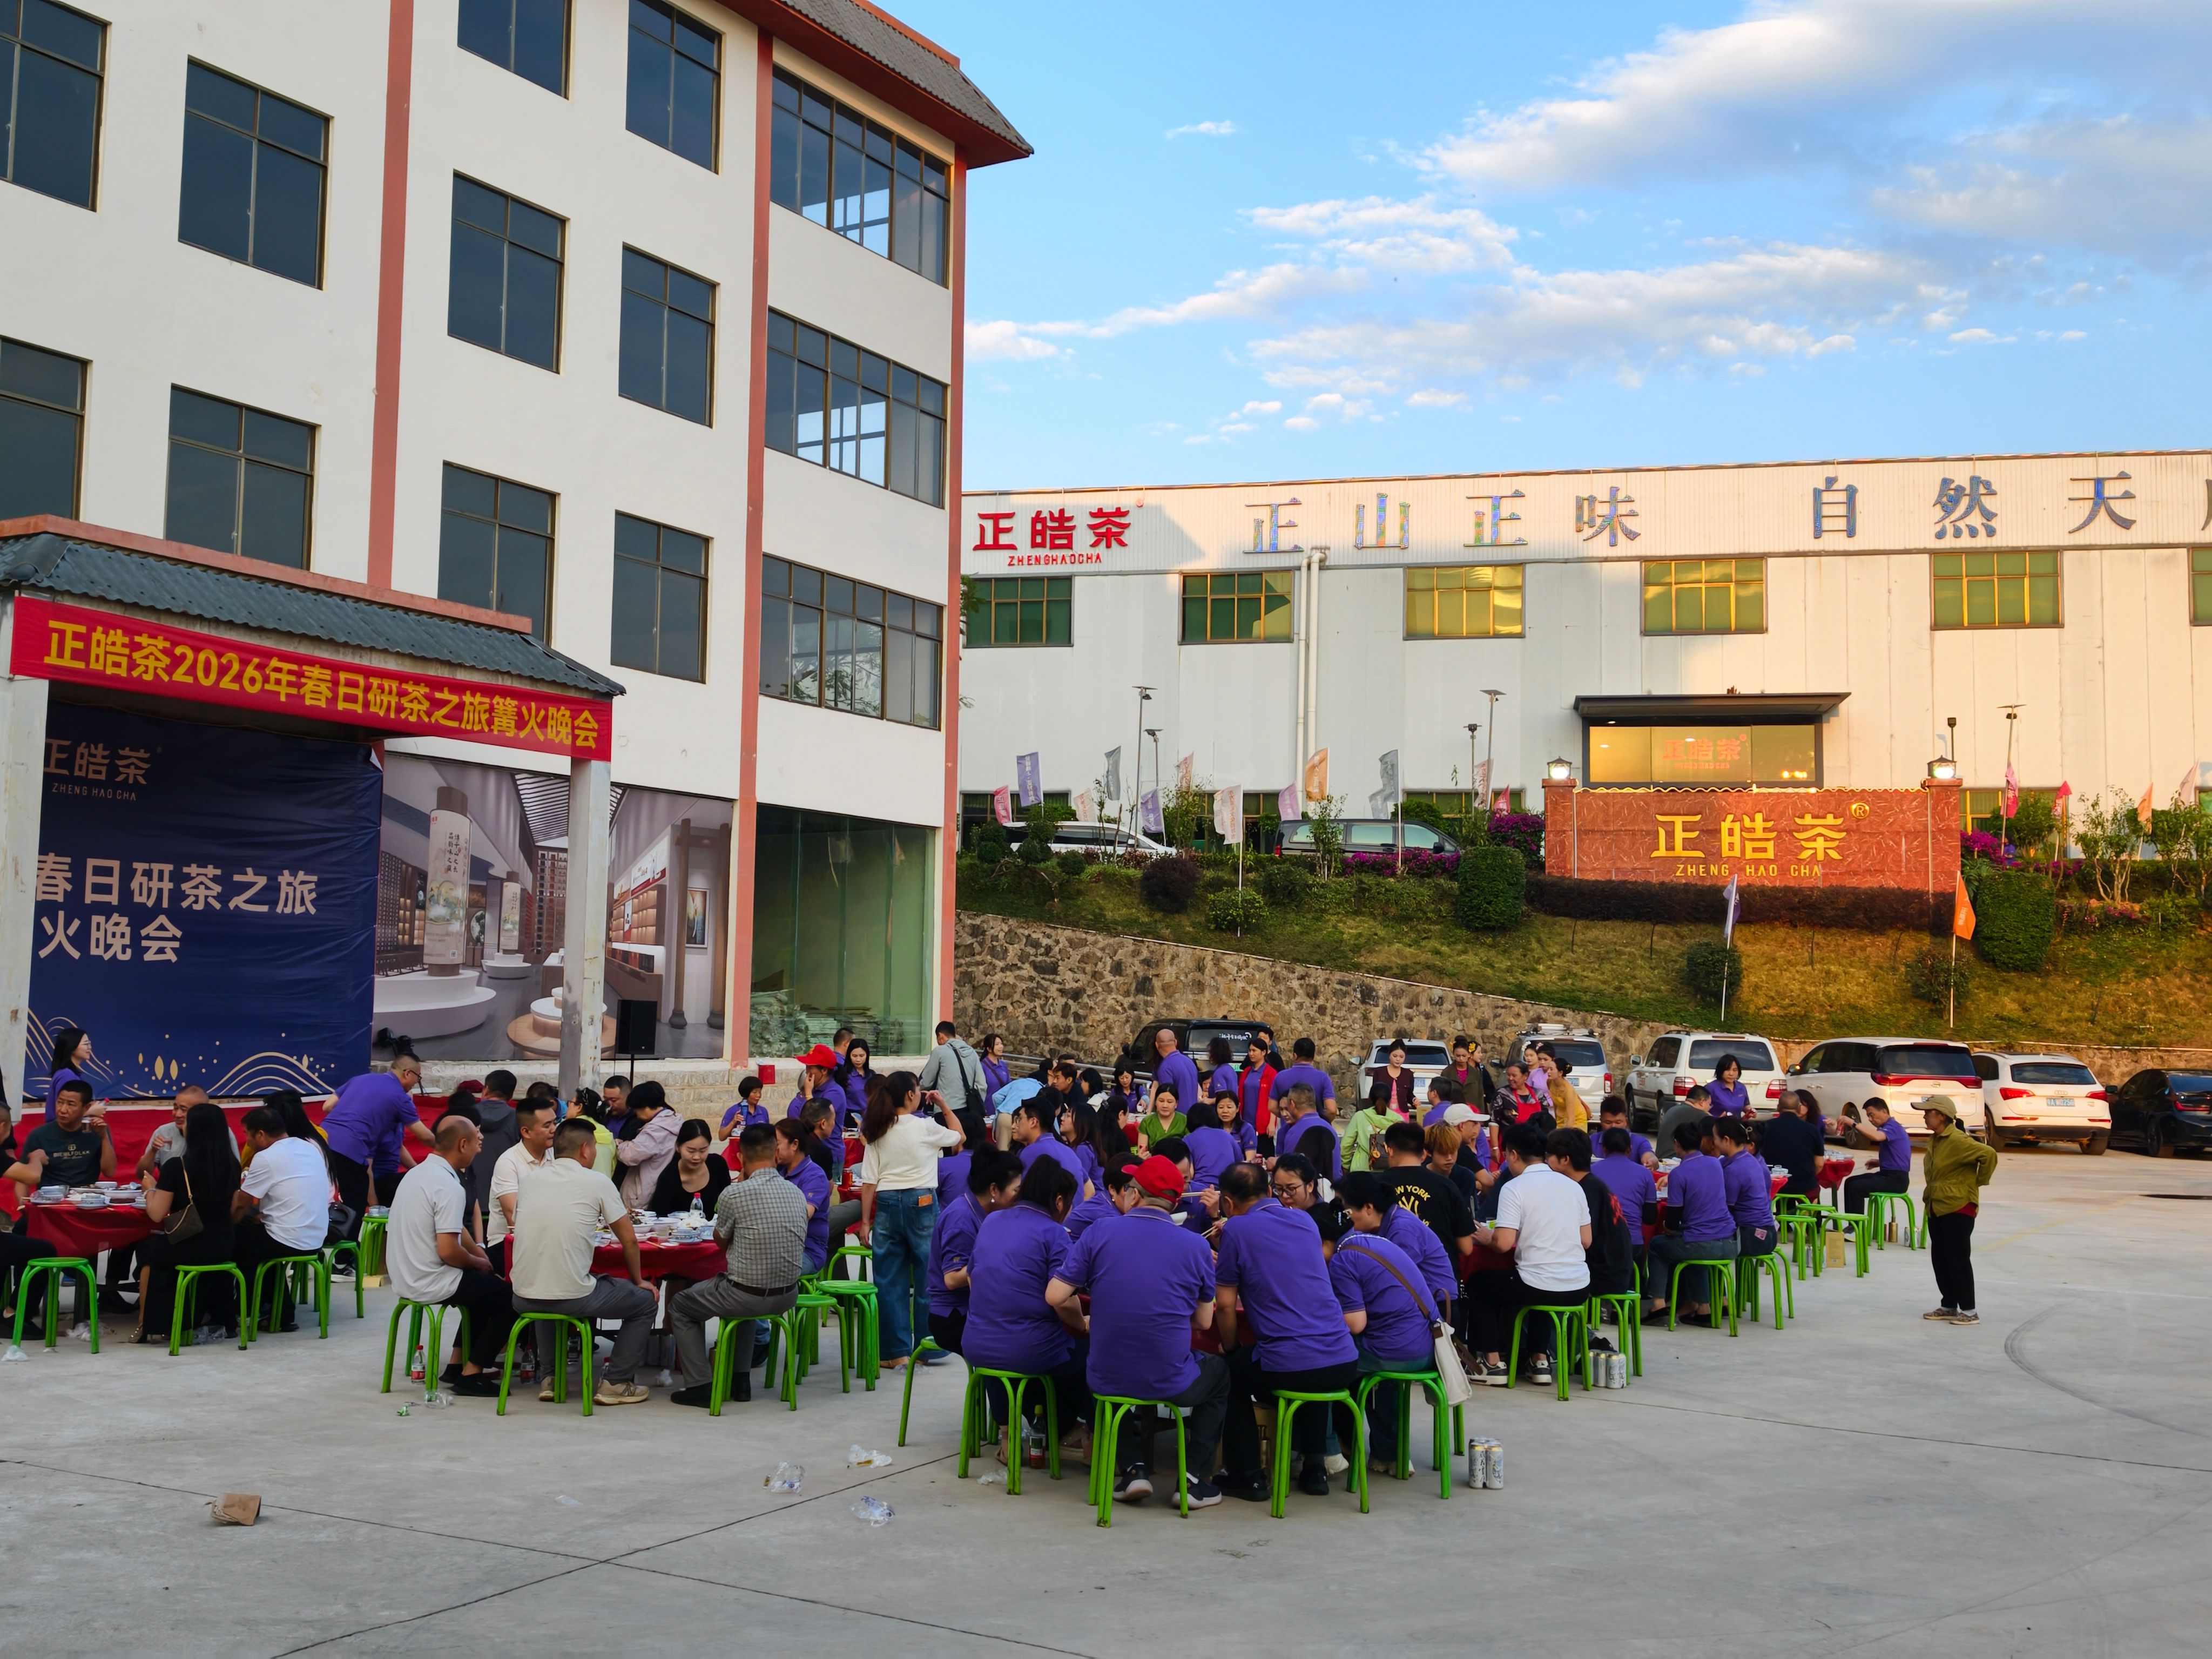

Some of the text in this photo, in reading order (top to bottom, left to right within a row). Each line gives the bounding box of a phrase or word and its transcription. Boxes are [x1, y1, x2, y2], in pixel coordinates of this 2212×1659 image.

[973, 507, 1131, 550] 正皓茶
[1243, 470, 2212, 554] 正山正味 自然天
[44, 620, 598, 748] 正皓茶2026年春日研茶之旅篝火晚会
[52, 783, 136, 801] ZHENG HAO CHA
[1650, 812, 1847, 861] 正皓茶
[36, 852, 318, 915] 春日研茶之旅
[1675, 864, 1820, 877] ZHENG HAO CHA
[38, 911, 183, 963] 火晚会
[1406, 1185, 1431, 1201] YORK
